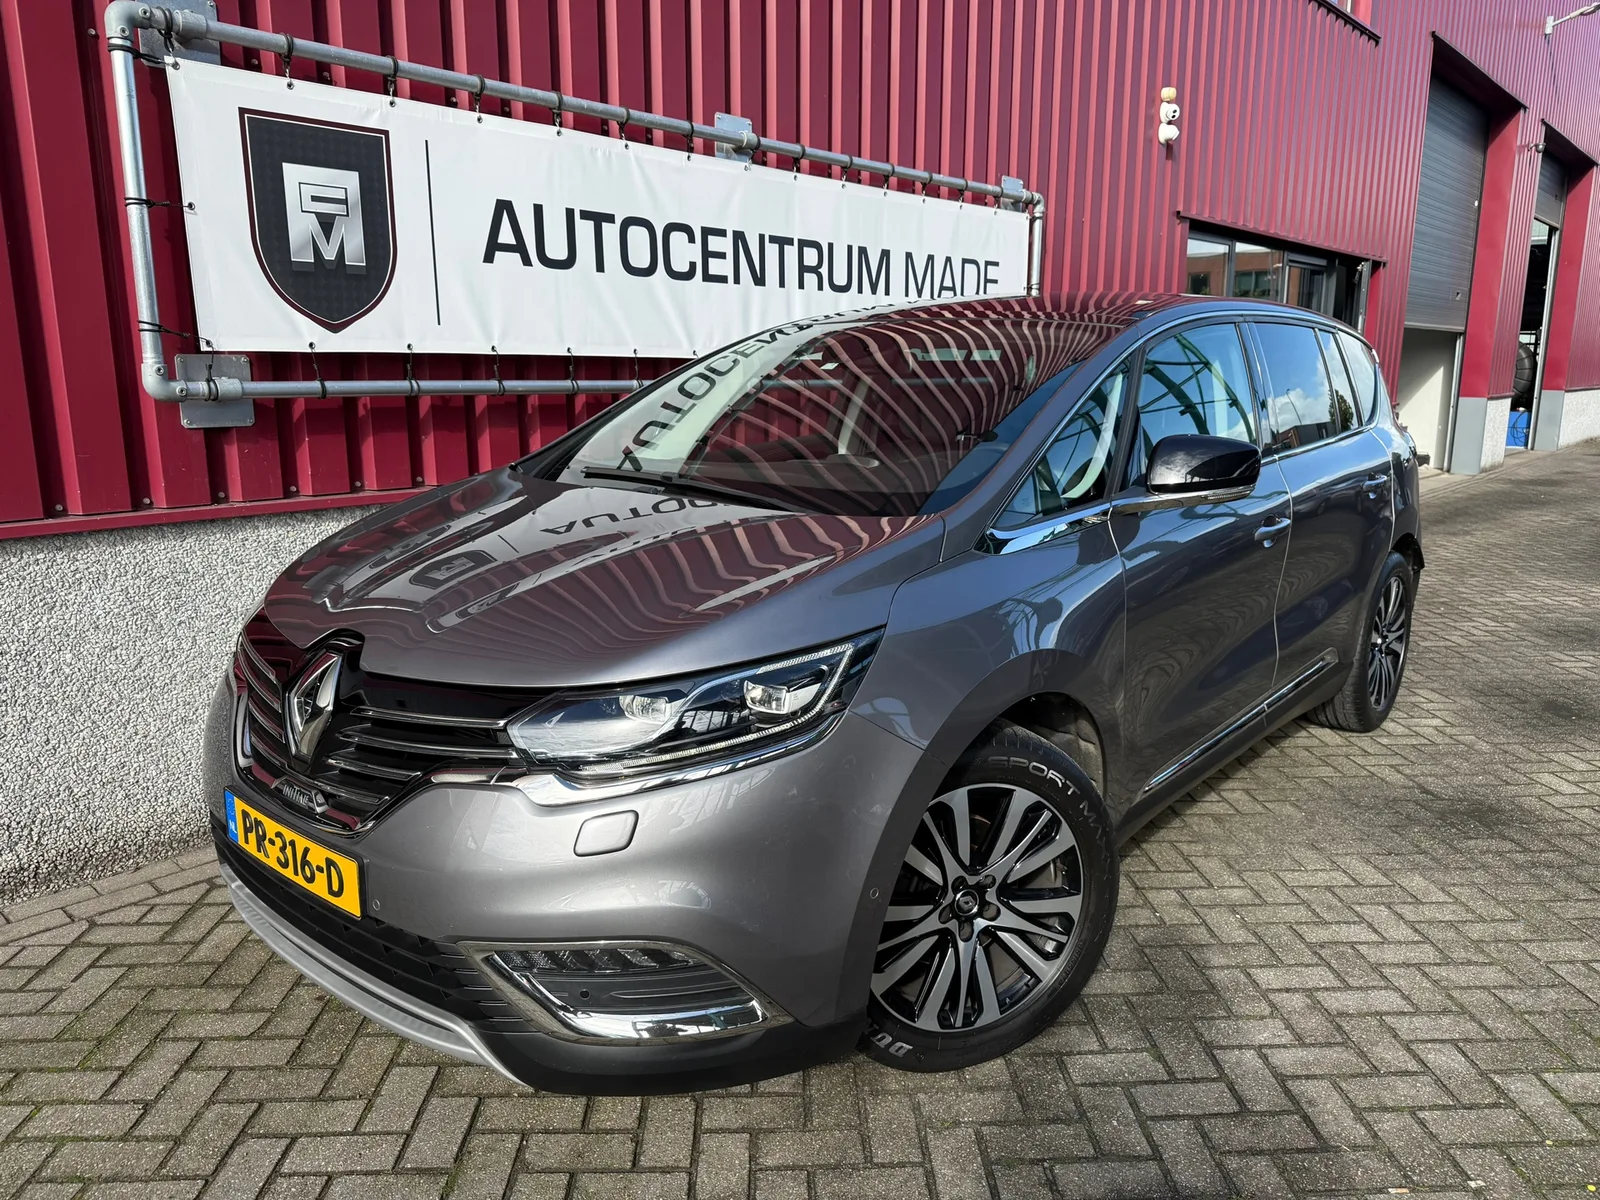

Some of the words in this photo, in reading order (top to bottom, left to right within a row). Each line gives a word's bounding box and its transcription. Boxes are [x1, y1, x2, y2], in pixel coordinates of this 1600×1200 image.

[482, 198, 892, 297] AUTOCENTRUM
[987, 756, 1081, 796] SPORT
[229, 819, 238, 834] NL
[241, 808, 344, 898] PR-316-D
